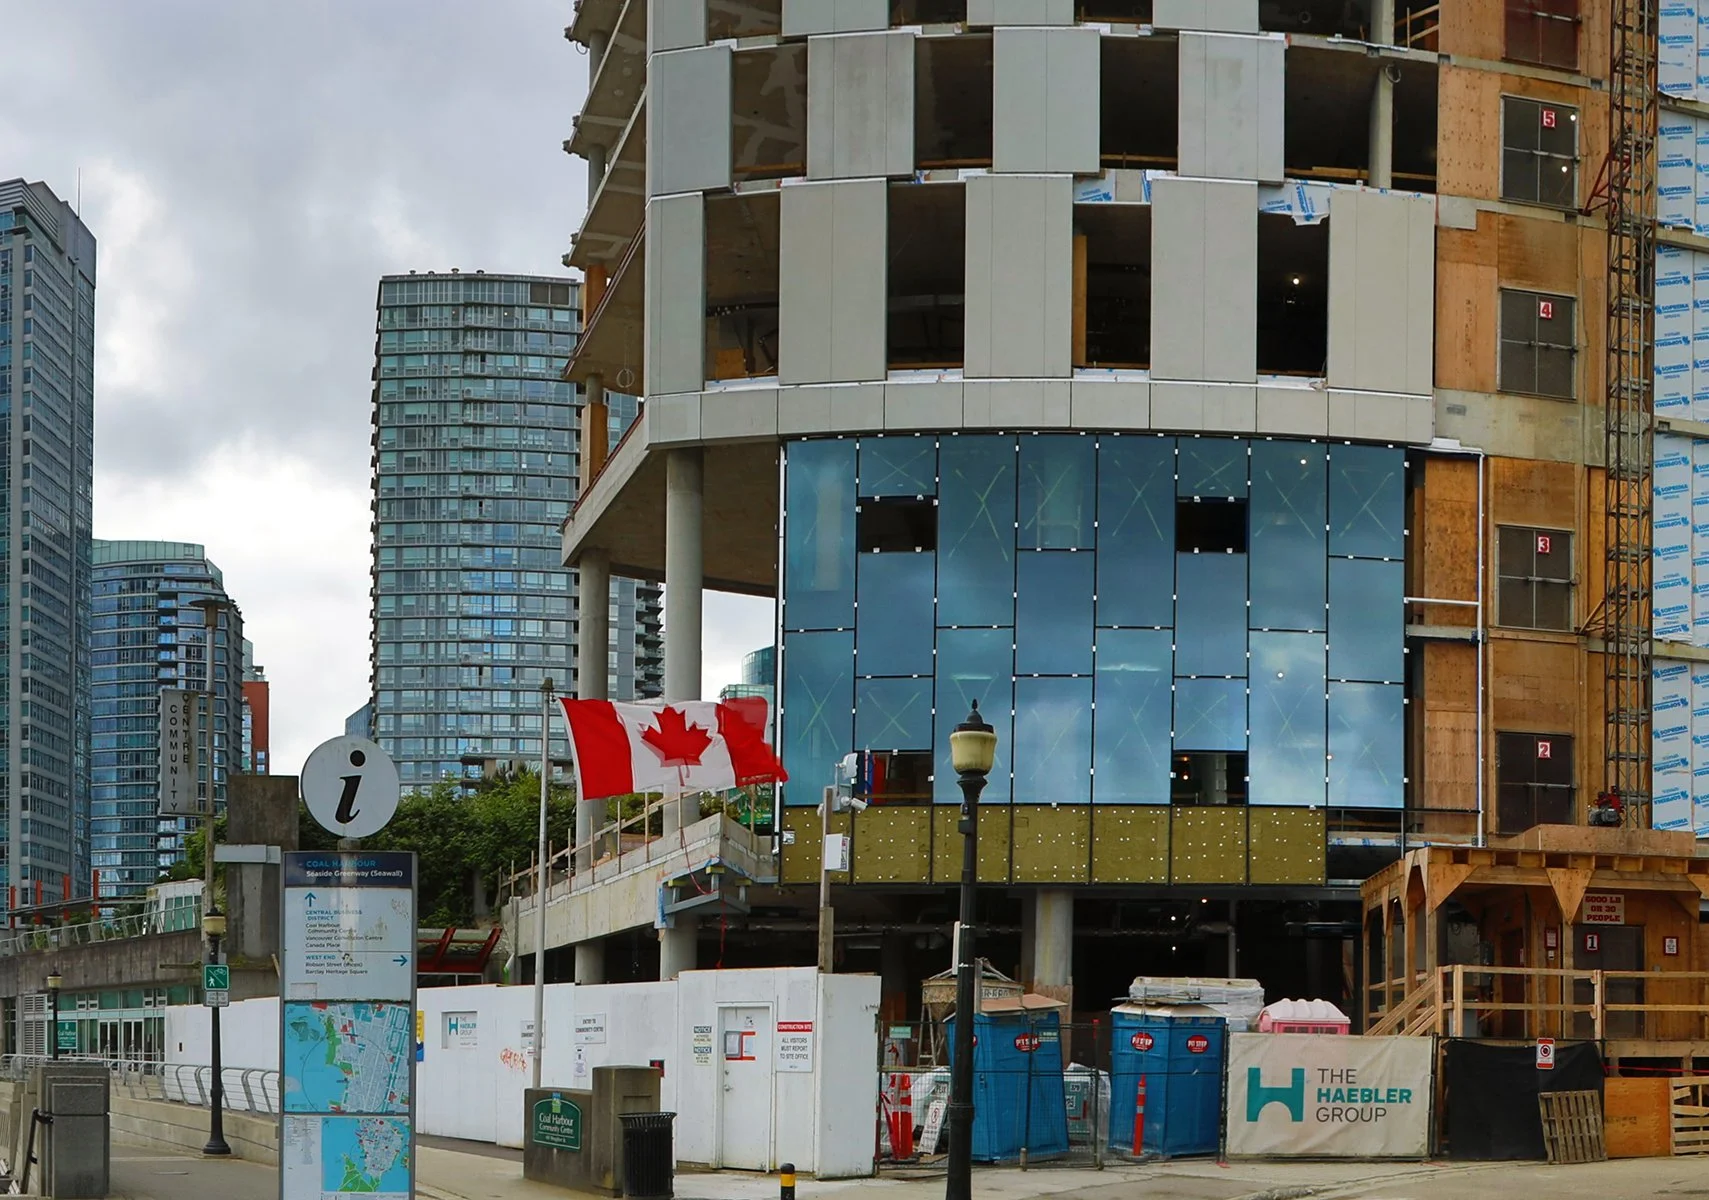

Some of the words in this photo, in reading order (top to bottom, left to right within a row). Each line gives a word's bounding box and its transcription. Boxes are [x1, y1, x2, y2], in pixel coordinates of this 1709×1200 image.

[1545, 112, 1554, 126] 5
[1542, 303, 1550, 316] 4
[1540, 539, 1548, 552] 3
[182, 693, 190, 763] CENTRE
[1540, 744, 1548, 757] 2
[169, 705, 178, 811] COMMUNITY
[307, 860, 329, 868] COAL
[334, 870, 368, 879] Greenway
[371, 870, 404, 878] (Seawall)
[1588, 935, 1596, 949] 1
[1317, 1068, 1357, 1084] THE
[1317, 1088, 1412, 1104] HAEBLER
[539, 1112, 551, 1124] Coal
[552, 1114, 574, 1127] Harbour
[1316, 1107, 1387, 1123] GROUP
[540, 1123, 560, 1134] Community
[560, 1126, 574, 1135] Centre
